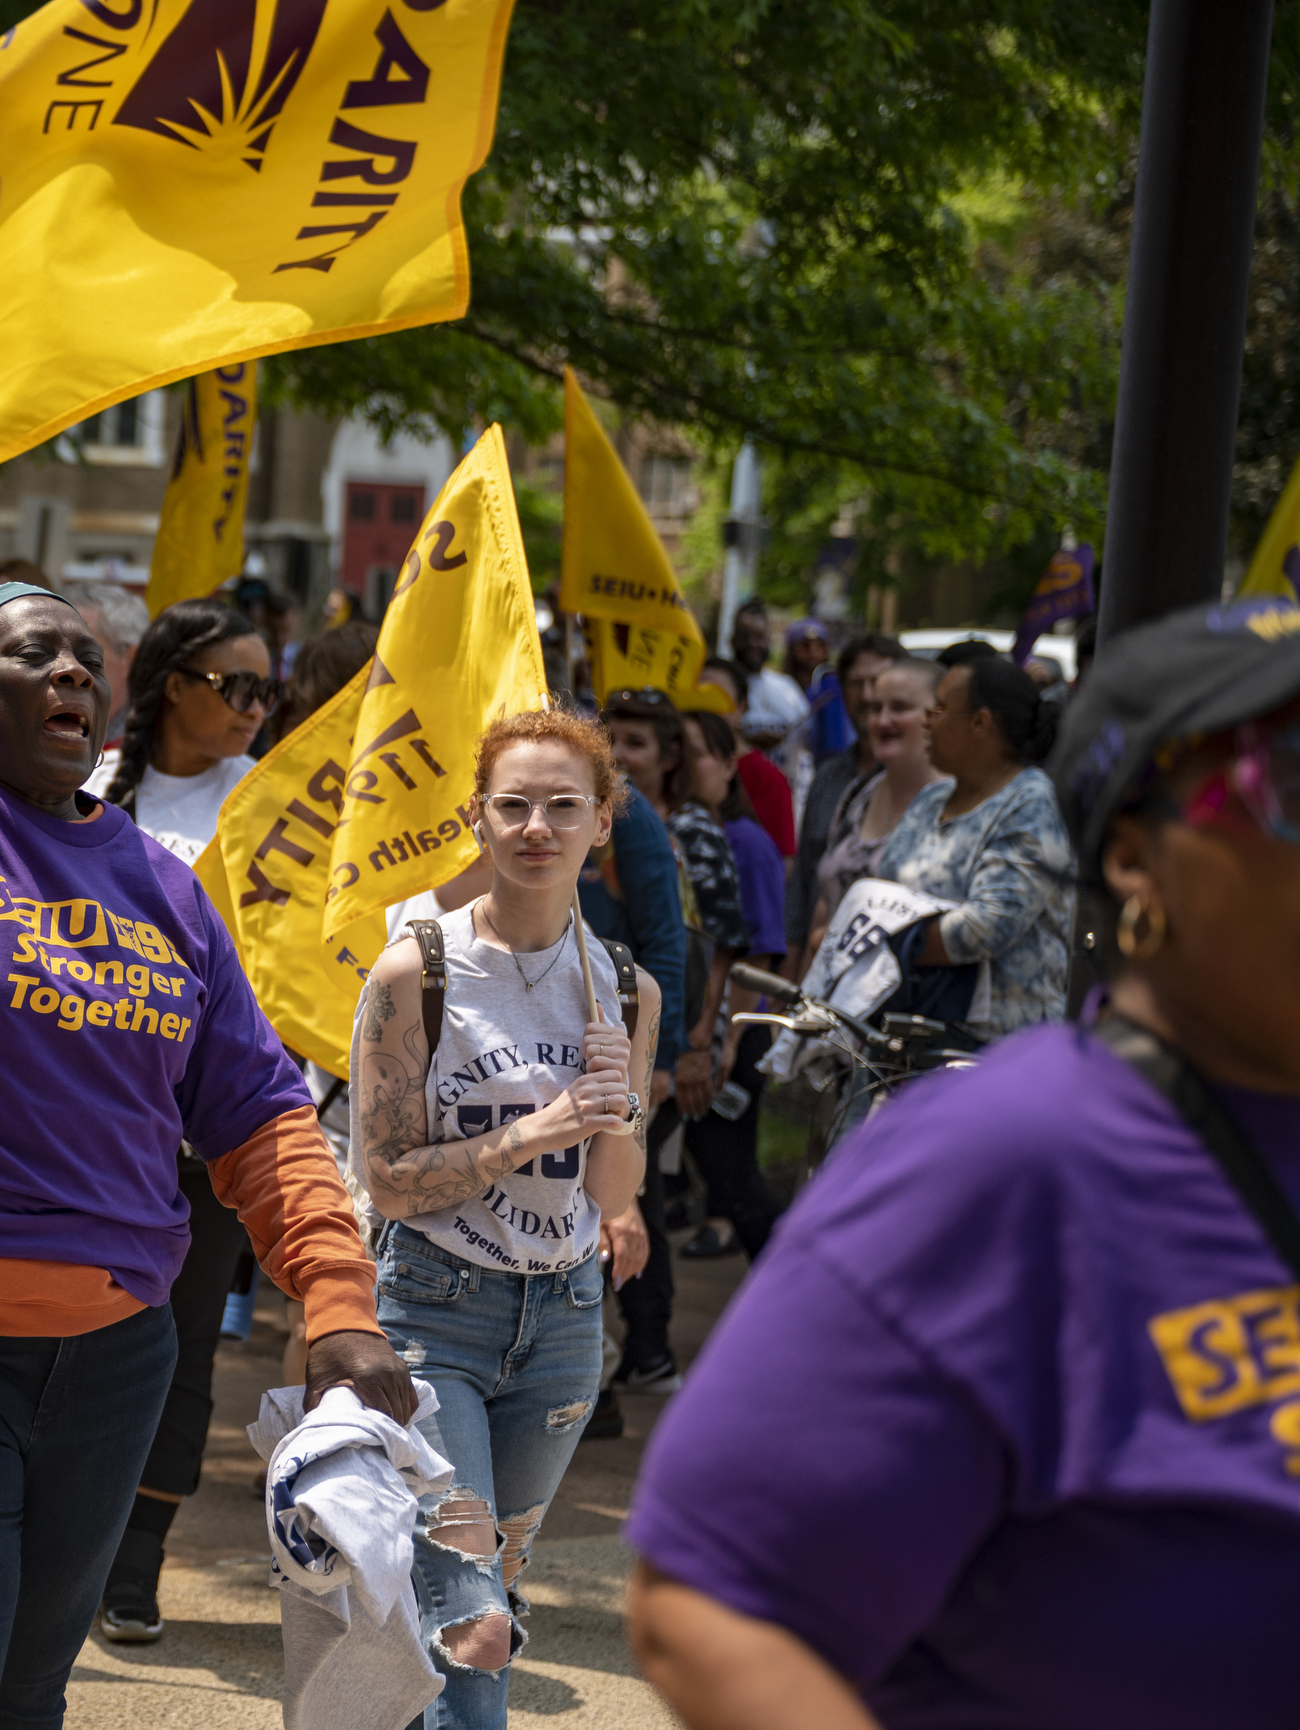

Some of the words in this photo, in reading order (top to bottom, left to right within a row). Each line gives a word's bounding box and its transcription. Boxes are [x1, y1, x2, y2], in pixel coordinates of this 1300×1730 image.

[12, 932, 186, 997] Stronger
[7, 973, 192, 1043] Together
[452, 1215, 521, 1270] Together,
[527, 1258, 551, 1272] We
